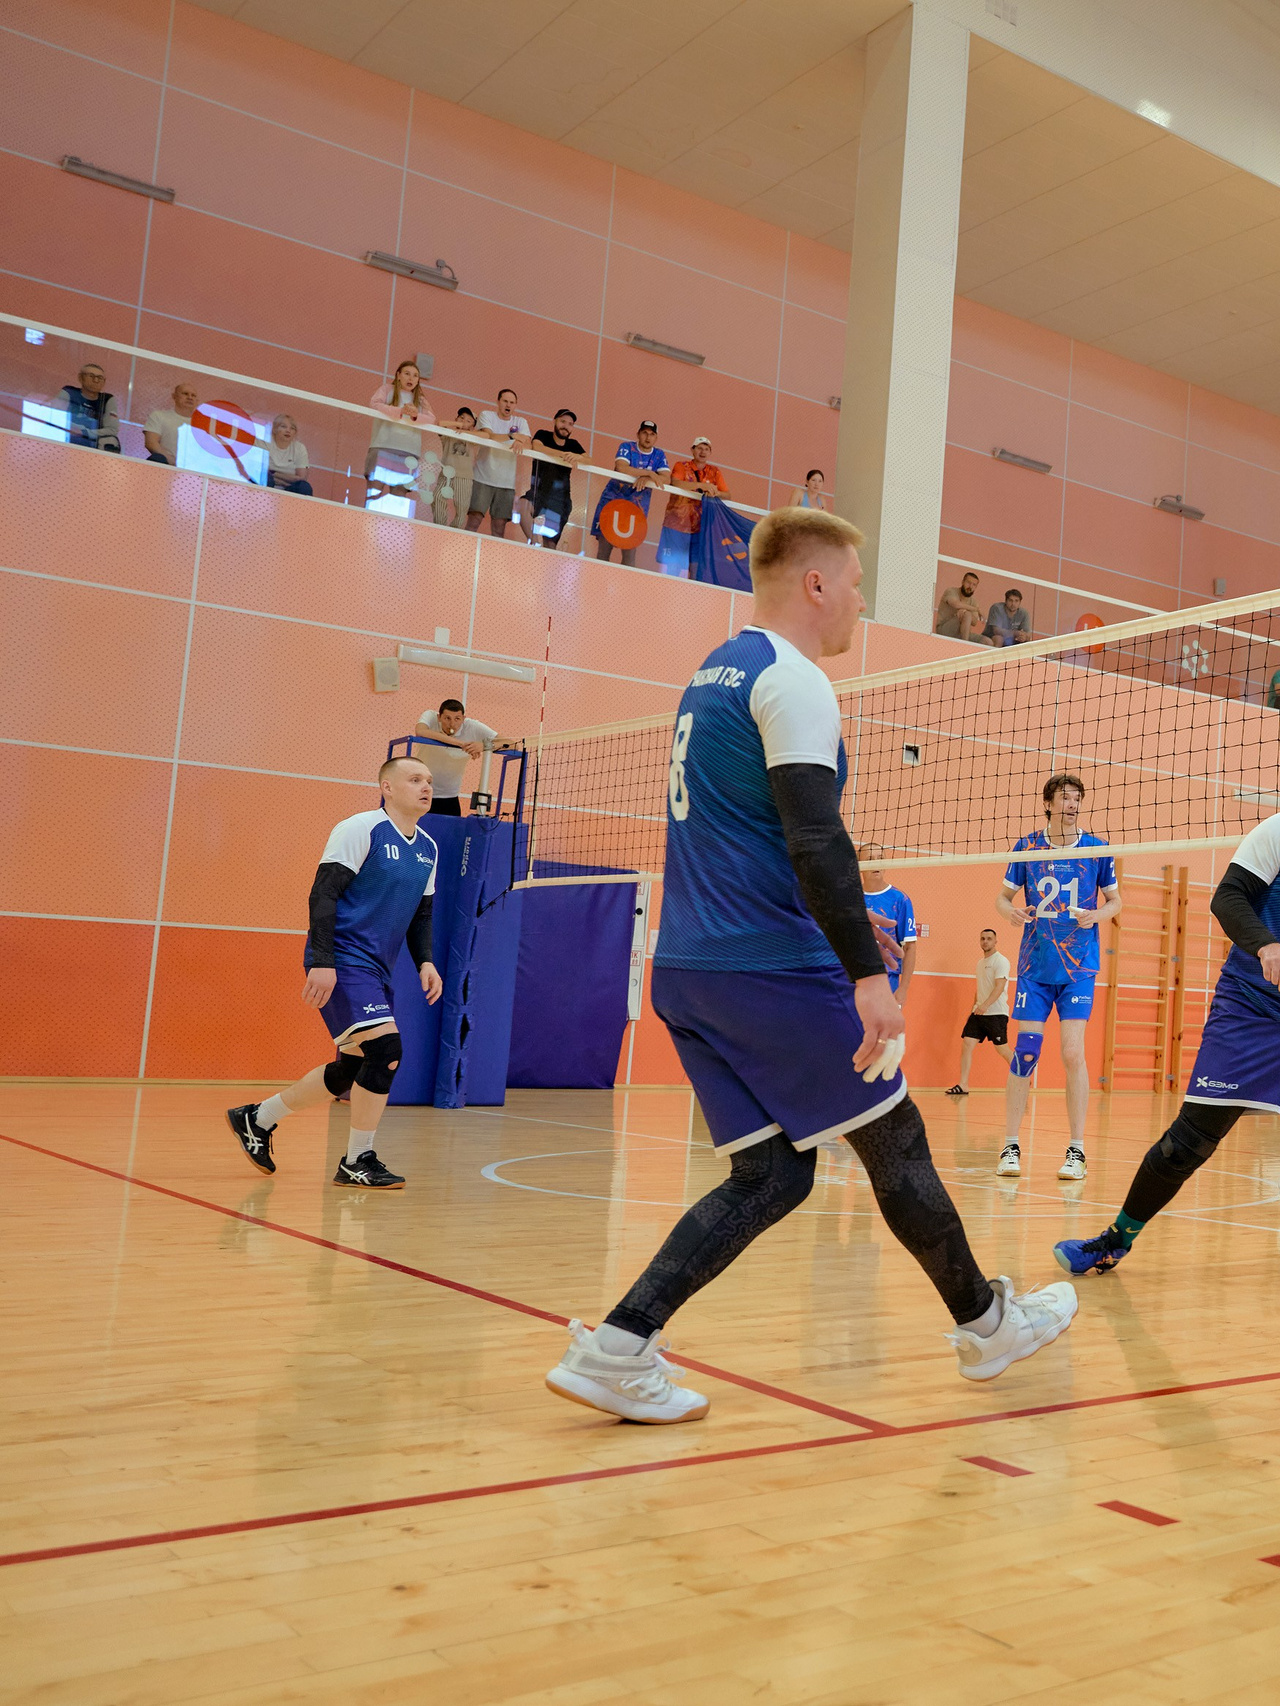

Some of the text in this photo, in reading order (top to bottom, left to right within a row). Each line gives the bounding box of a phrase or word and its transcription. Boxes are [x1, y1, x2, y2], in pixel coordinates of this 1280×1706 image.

[612, 510, 636, 538] U
[669, 712, 693, 821] 8
[383, 843, 400, 860] 10
[1035, 876, 1079, 919] 21
[1015, 991, 1028, 1009] 21
